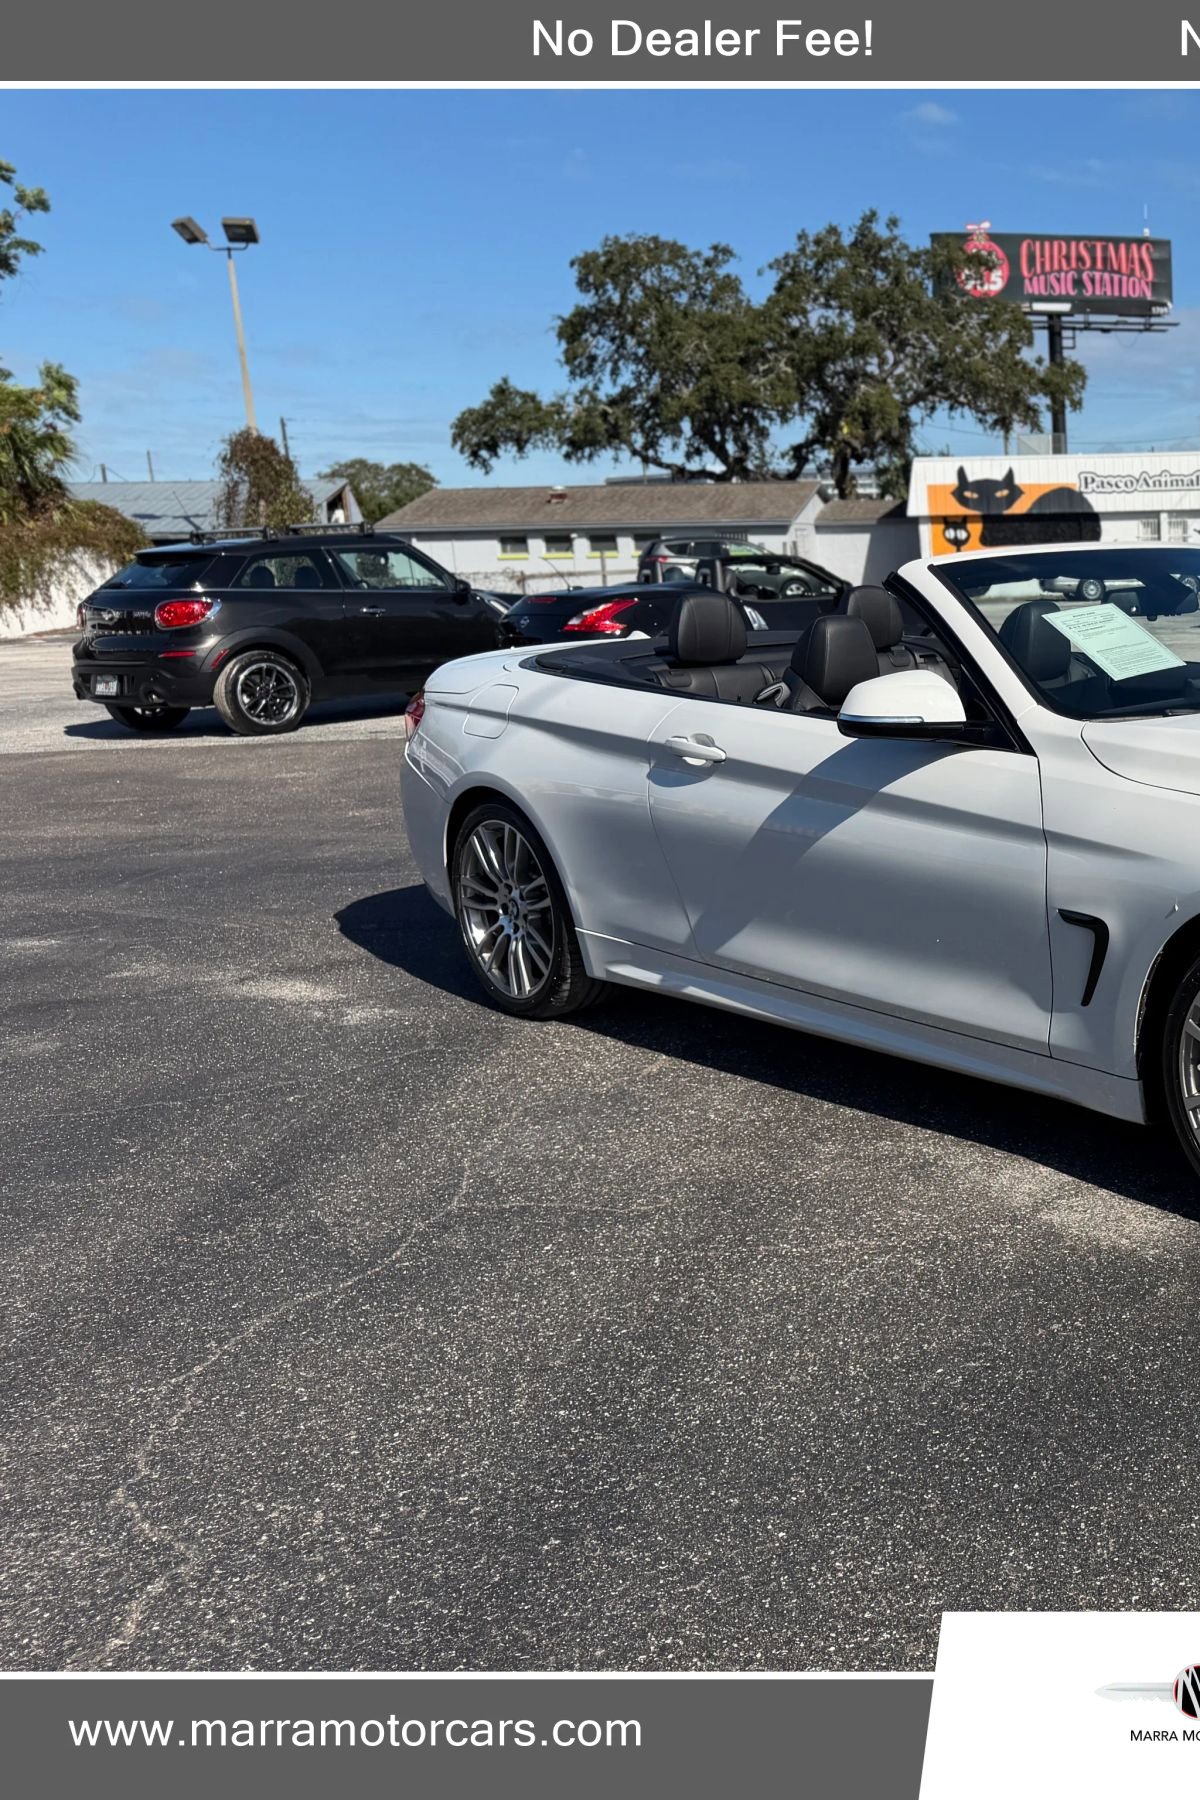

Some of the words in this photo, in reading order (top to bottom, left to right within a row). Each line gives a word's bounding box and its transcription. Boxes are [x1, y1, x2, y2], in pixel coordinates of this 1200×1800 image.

[1020, 239, 1154, 282] CHRISTMAS
[1023, 271, 1078, 296] MUSIC
[1082, 270, 1153, 300] STATION
[1082, 475, 1136, 490] Pasco
[1138, 473, 1200, 489] Animal
